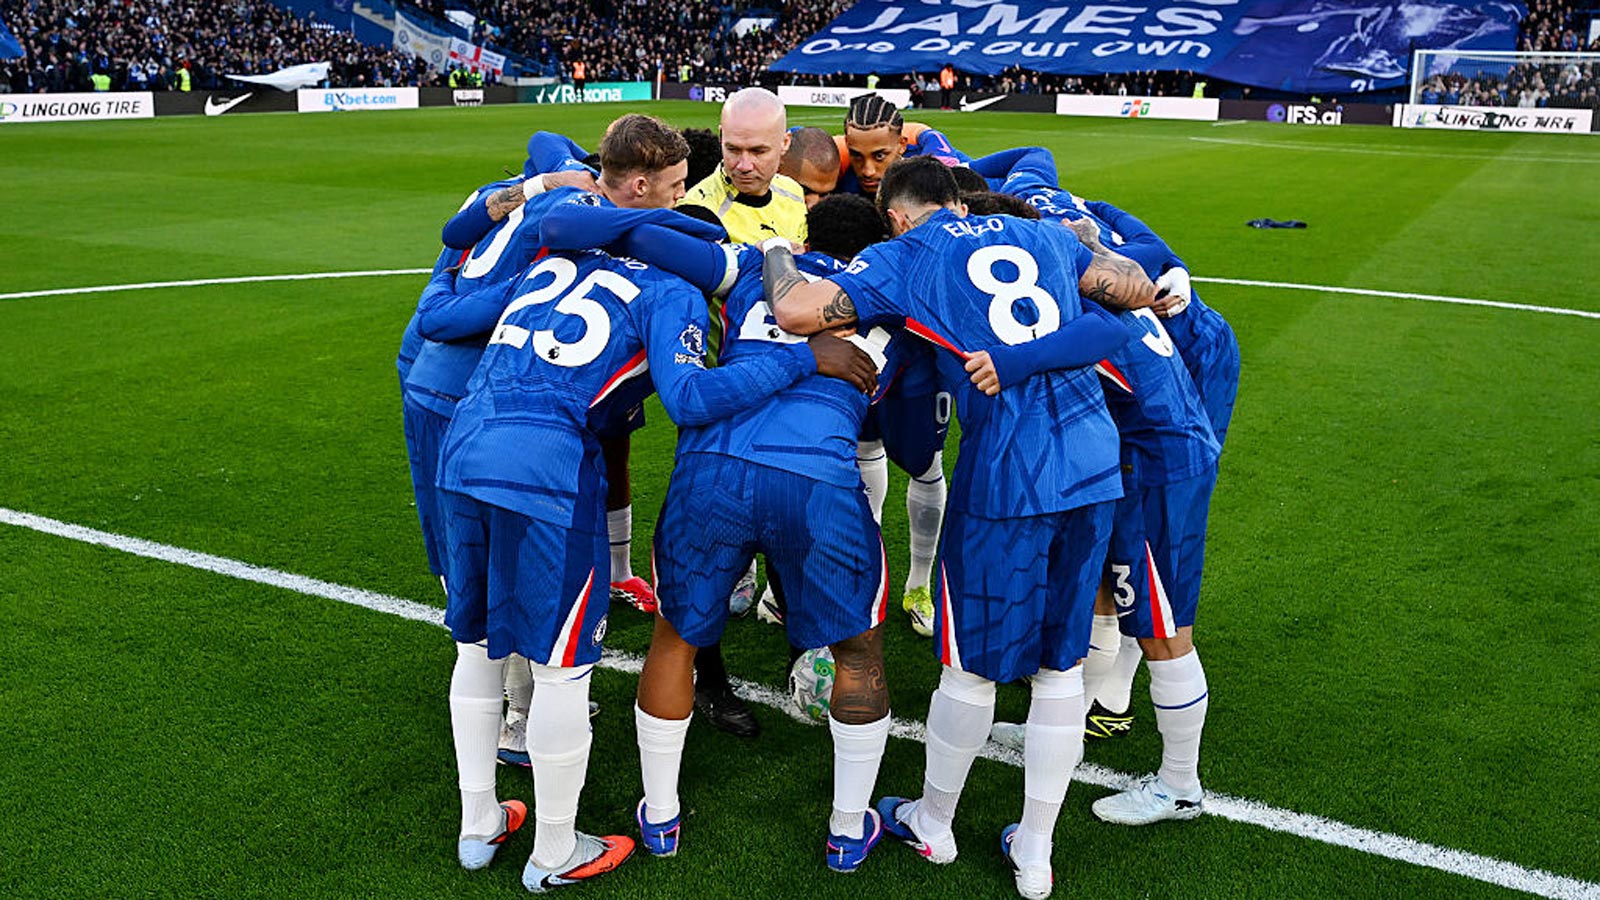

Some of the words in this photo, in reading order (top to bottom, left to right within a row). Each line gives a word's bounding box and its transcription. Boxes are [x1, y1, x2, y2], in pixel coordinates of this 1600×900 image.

[831, 4, 1223, 37] JAMES
[801, 38, 895, 54] One
[1092, 40, 1212, 58] own
[22, 102, 101, 117] LINGLONG
[106, 100, 141, 114] TIRE
[810, 92, 847, 105] CARLING
[1287, 104, 1342, 125] IFS.ai
[1443, 111, 1528, 128] LINGLNG
[942, 218, 1004, 238] ENZO
[967, 245, 1061, 346] 8
[489, 257, 642, 367] 25
[1112, 564, 1135, 607] 3
